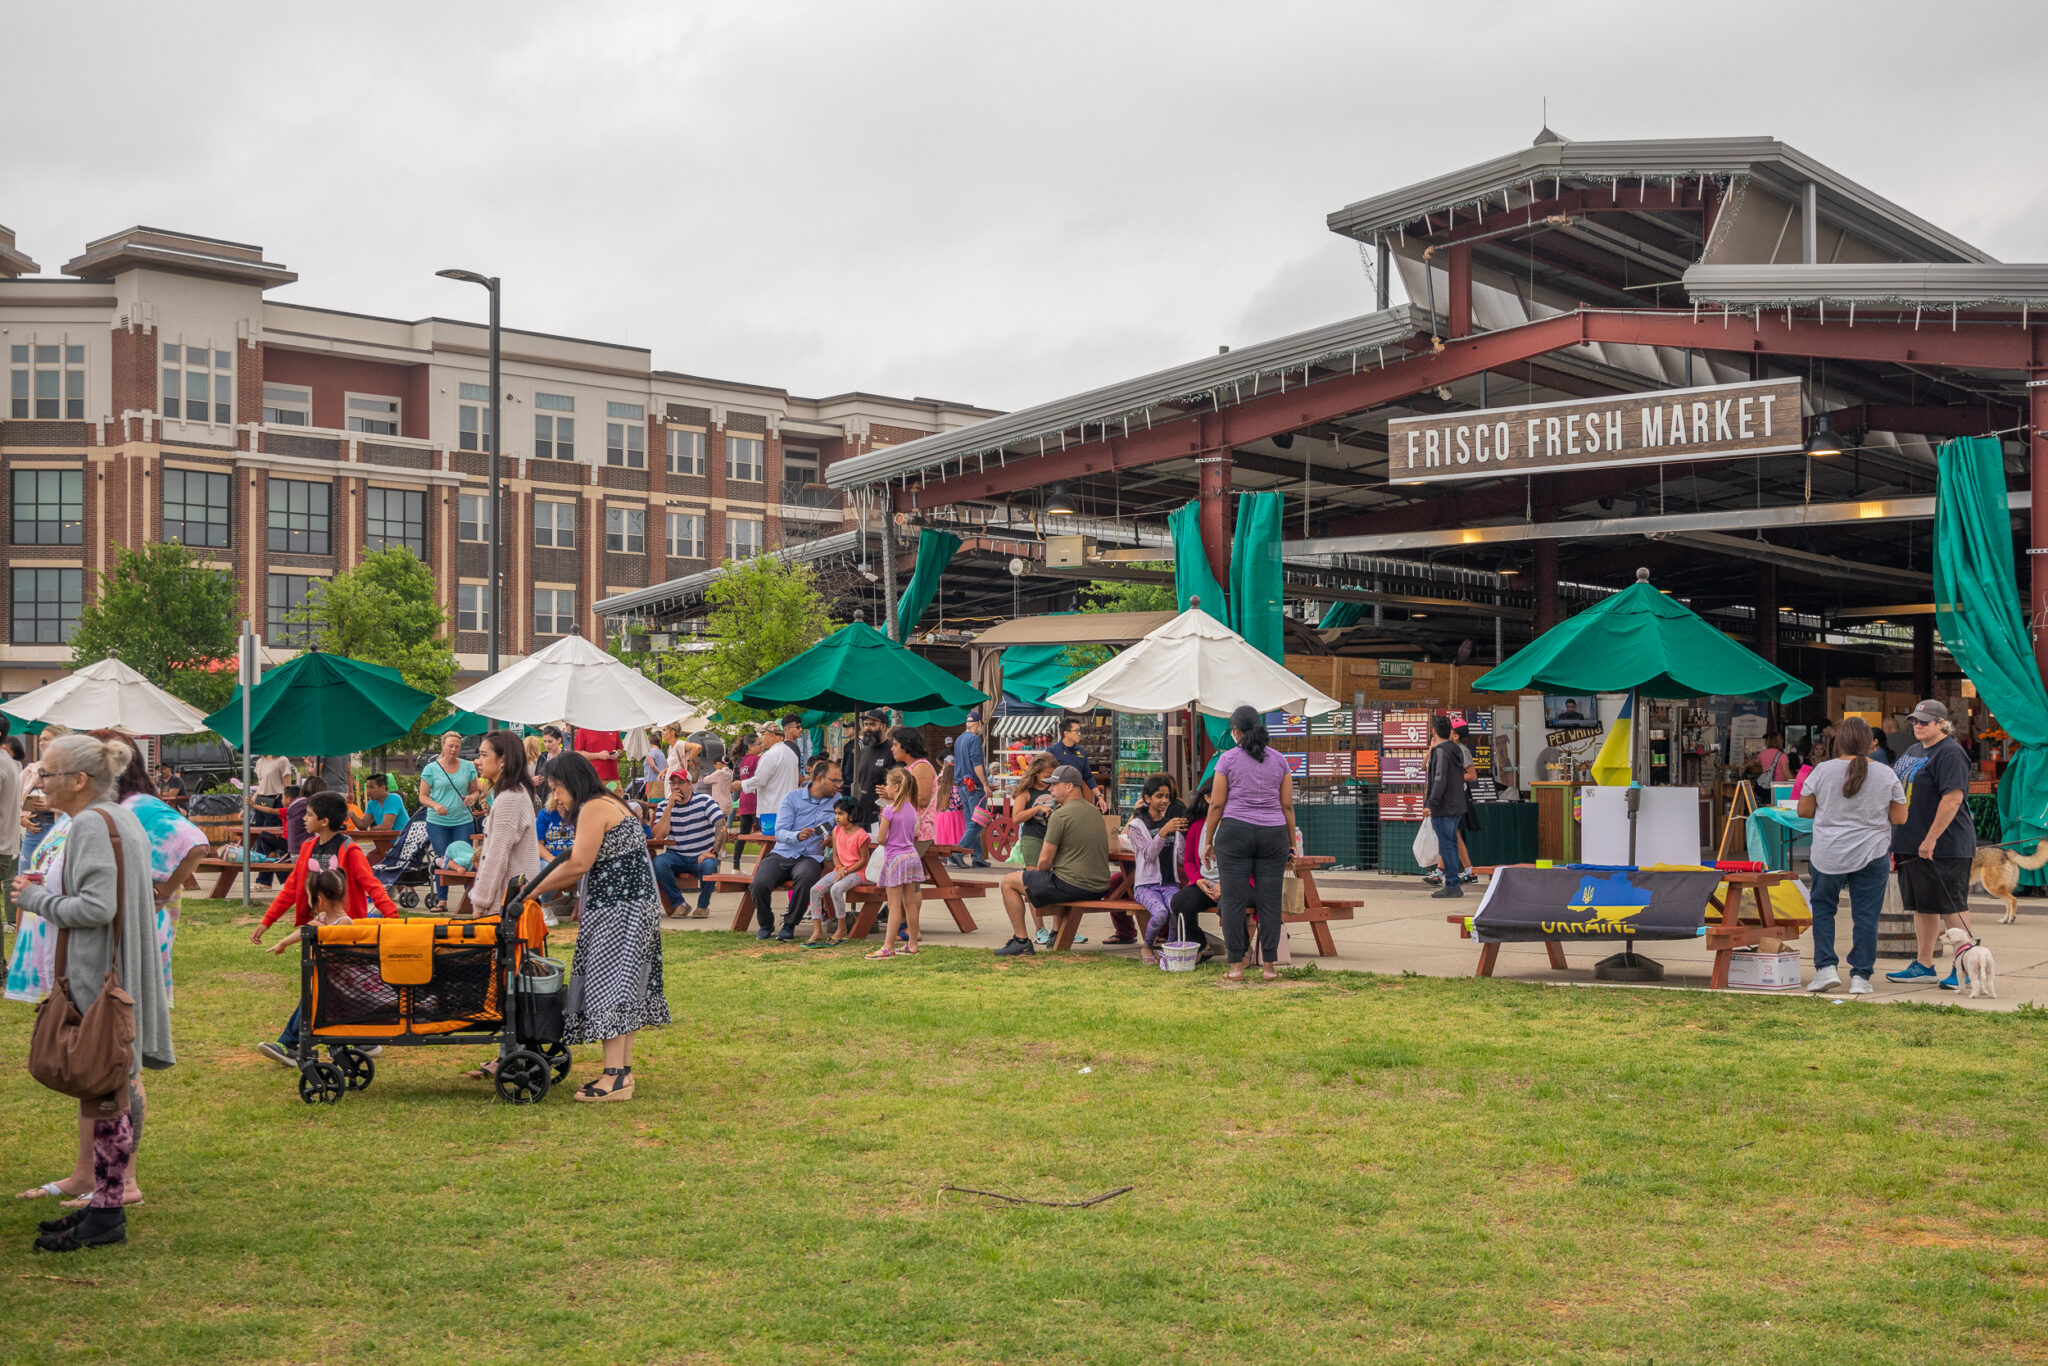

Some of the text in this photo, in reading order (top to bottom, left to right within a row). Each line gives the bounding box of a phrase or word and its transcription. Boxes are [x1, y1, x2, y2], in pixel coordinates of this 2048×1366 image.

[1408, 394, 1777, 469] FRISCO FRESH MARKET
[1380, 662, 1390, 674] PET
[1390, 663, 1406, 675] WANTS
[1549, 731, 1566, 746] PET
